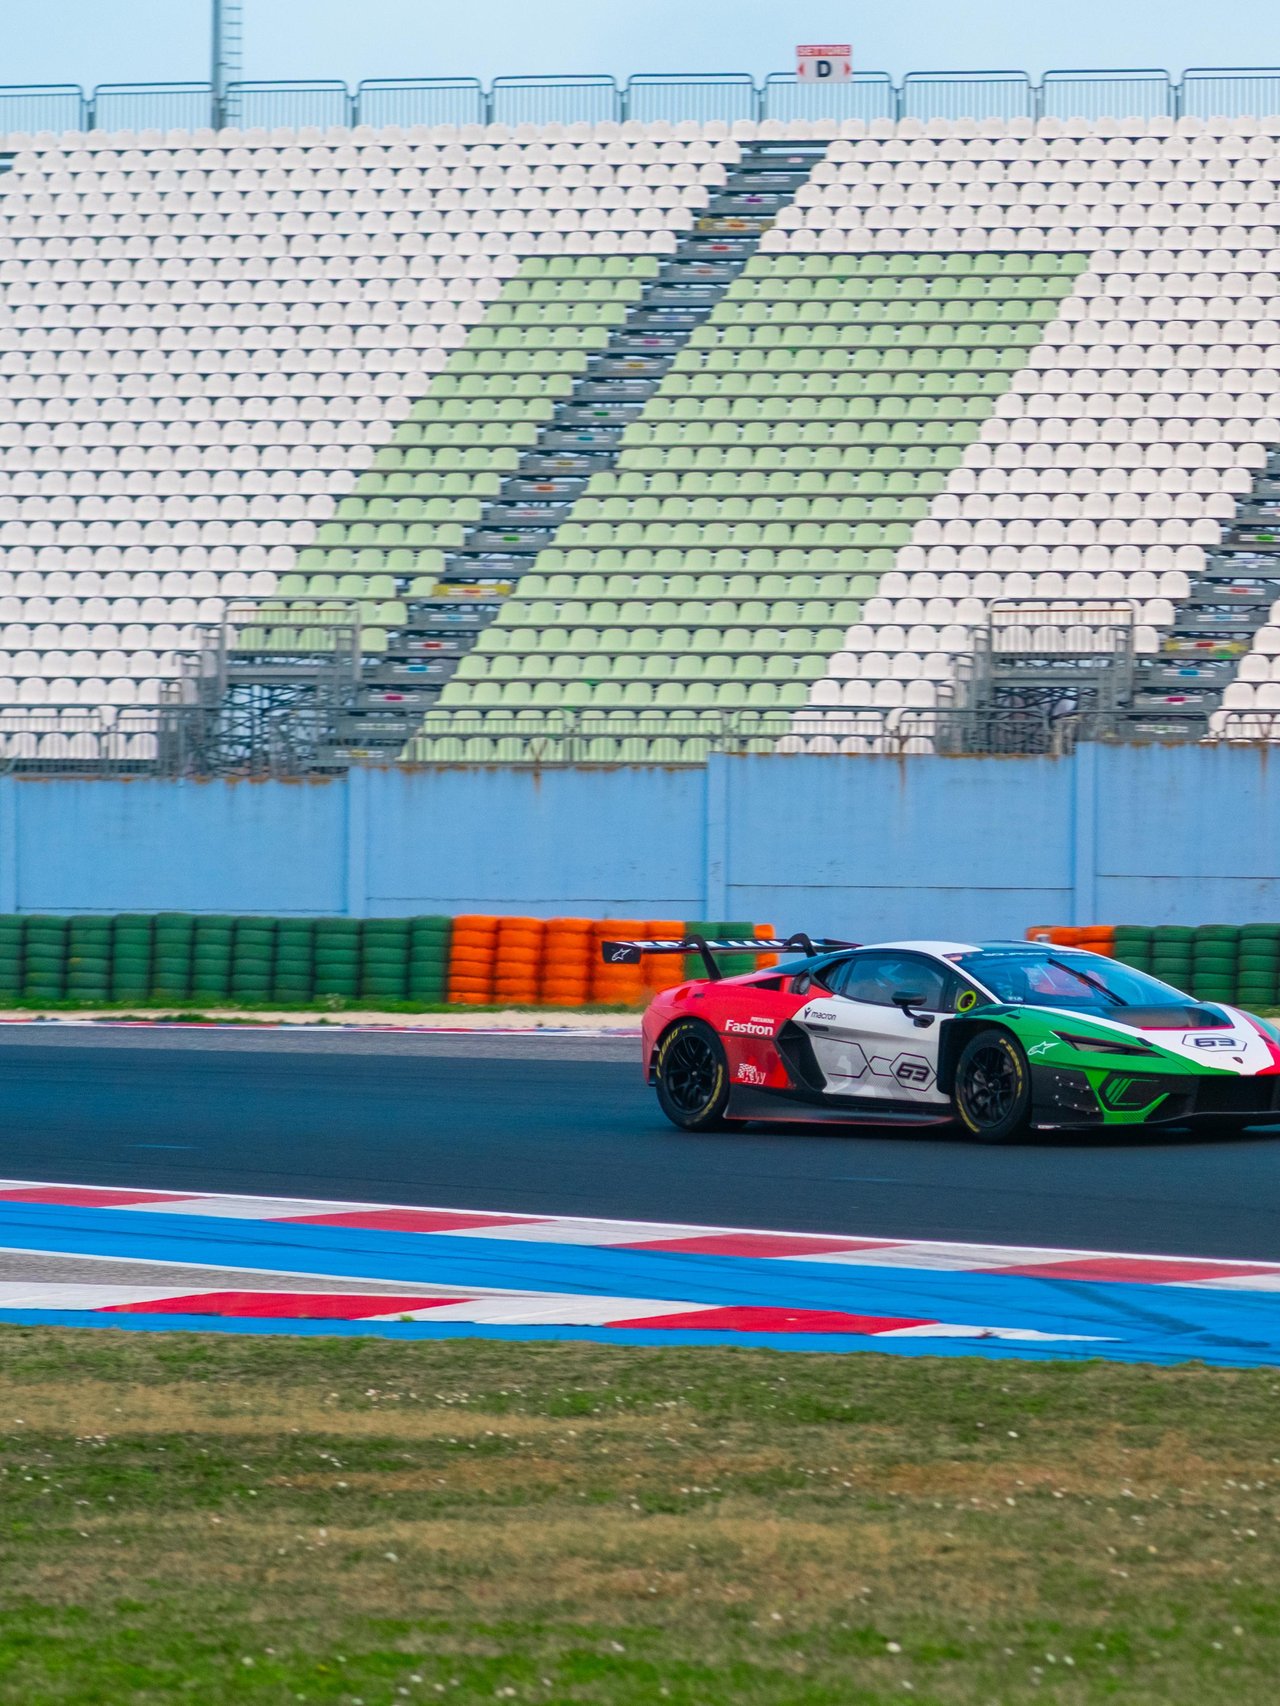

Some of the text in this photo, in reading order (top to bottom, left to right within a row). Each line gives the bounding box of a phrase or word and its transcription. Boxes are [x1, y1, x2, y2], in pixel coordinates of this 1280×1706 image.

[815, 60, 832, 78] D
[811, 1011, 837, 1021] macron
[725, 1019, 774, 1036] Fastron
[1194, 1037, 1236, 1047] 63
[896, 1062, 931, 1083] 63
